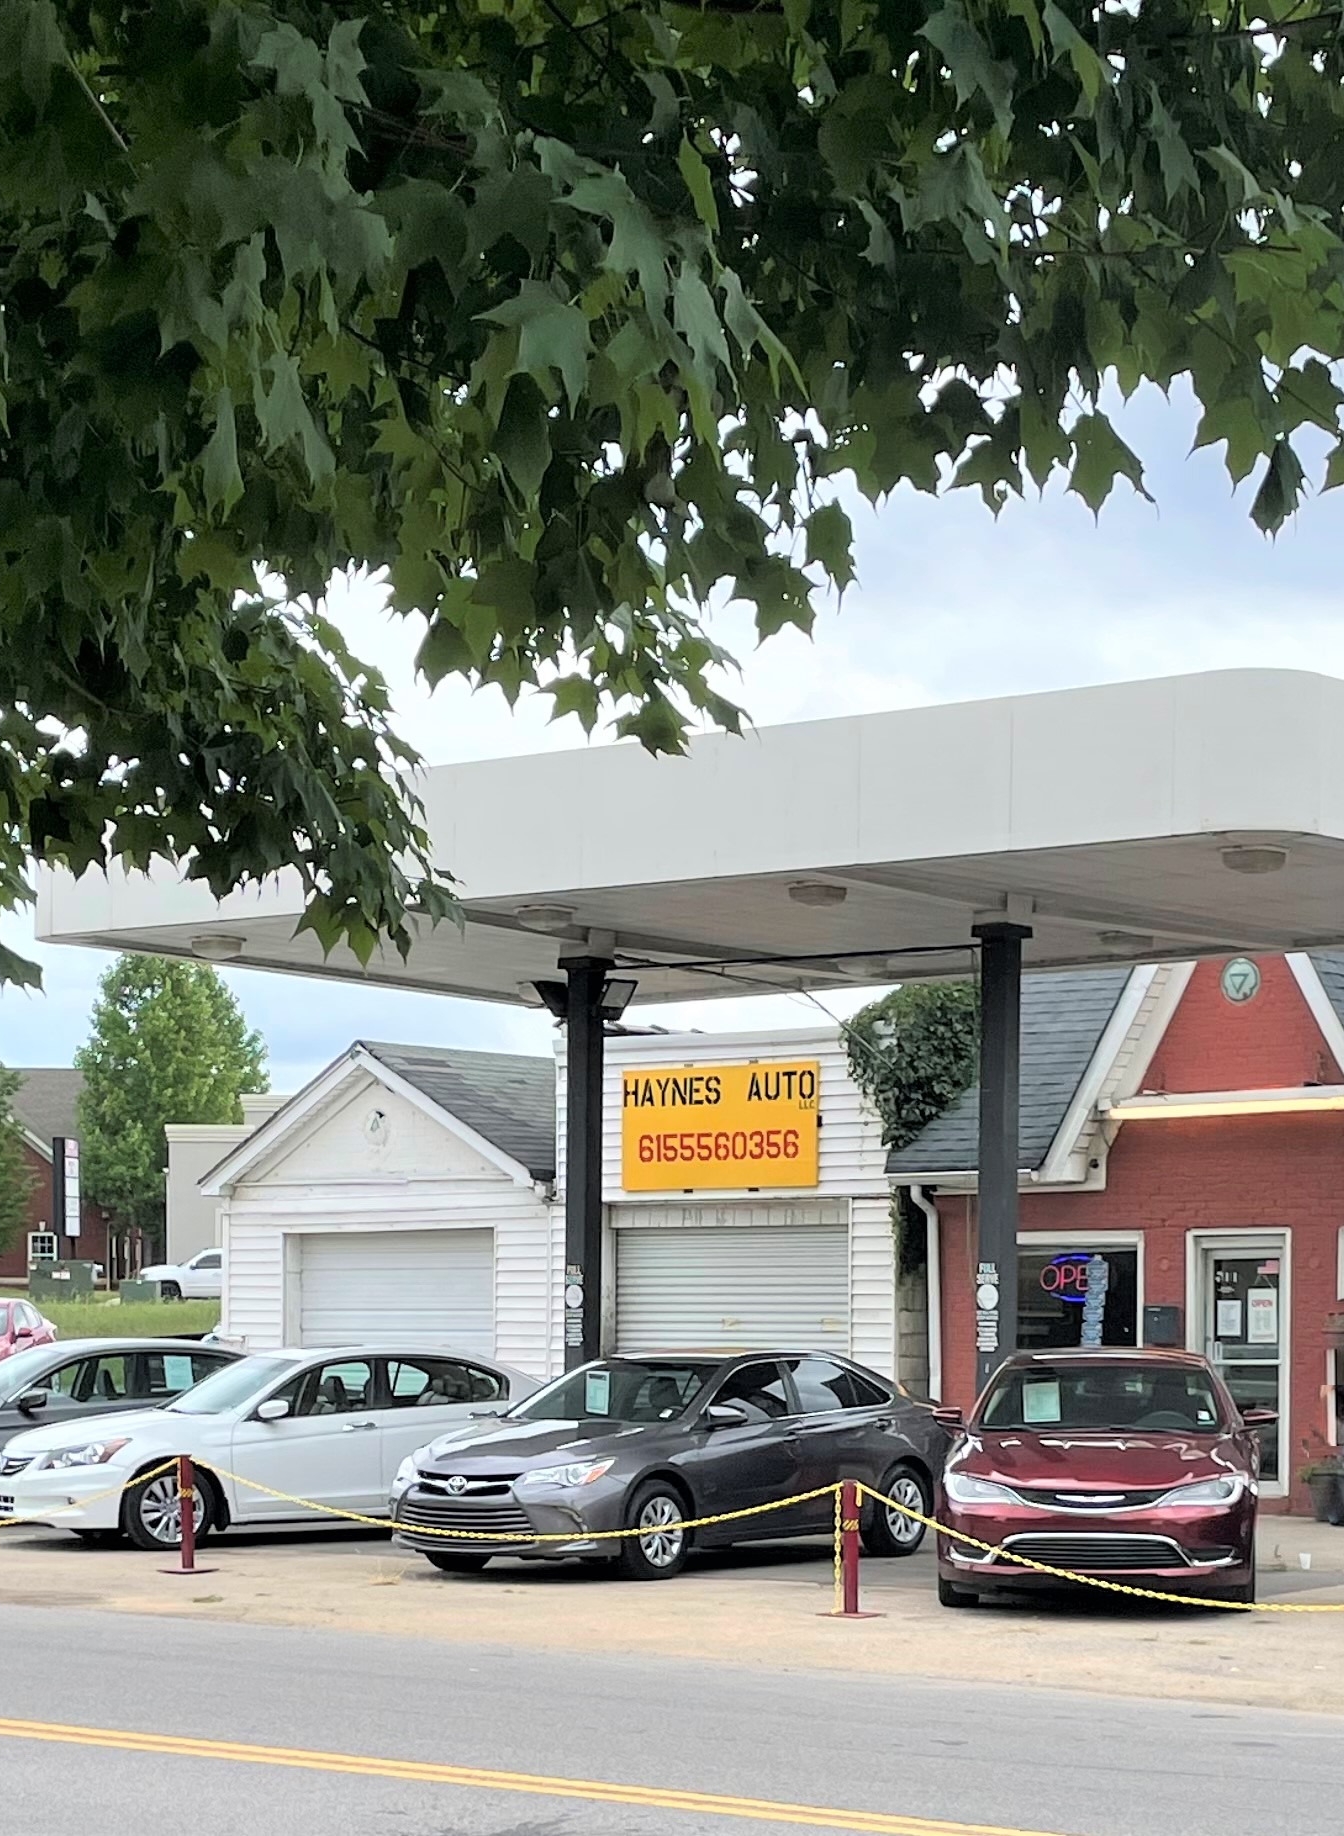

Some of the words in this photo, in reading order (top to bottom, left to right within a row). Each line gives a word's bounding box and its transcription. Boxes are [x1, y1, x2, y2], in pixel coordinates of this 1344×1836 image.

[623, 1075, 721, 1108] HAYNES
[747, 1069, 815, 1102] AUTO
[798, 1100, 815, 1110] LLC
[639, 1129, 799, 1163] 6155560356
[1040, 1264, 1091, 1291] OPE
